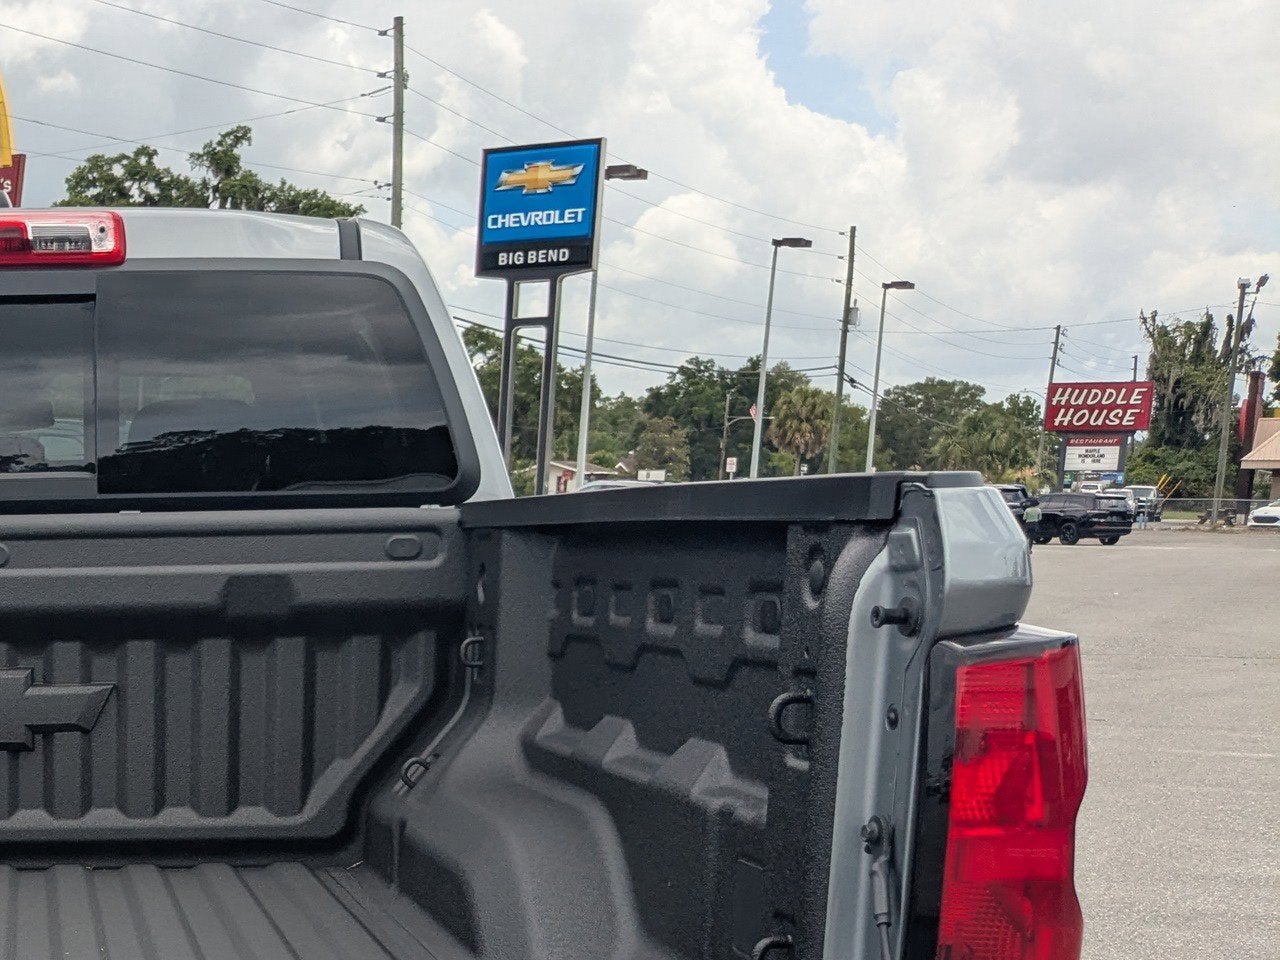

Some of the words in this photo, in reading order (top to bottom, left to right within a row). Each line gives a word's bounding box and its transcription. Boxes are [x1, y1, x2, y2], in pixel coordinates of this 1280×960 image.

[487, 208, 586, 229] CHEVROLET
[498, 252, 524, 266] BIG
[527, 249, 570, 264] BEND
[1051, 387, 1148, 405] HUDDLE
[1053, 408, 1140, 426] HOUSE
